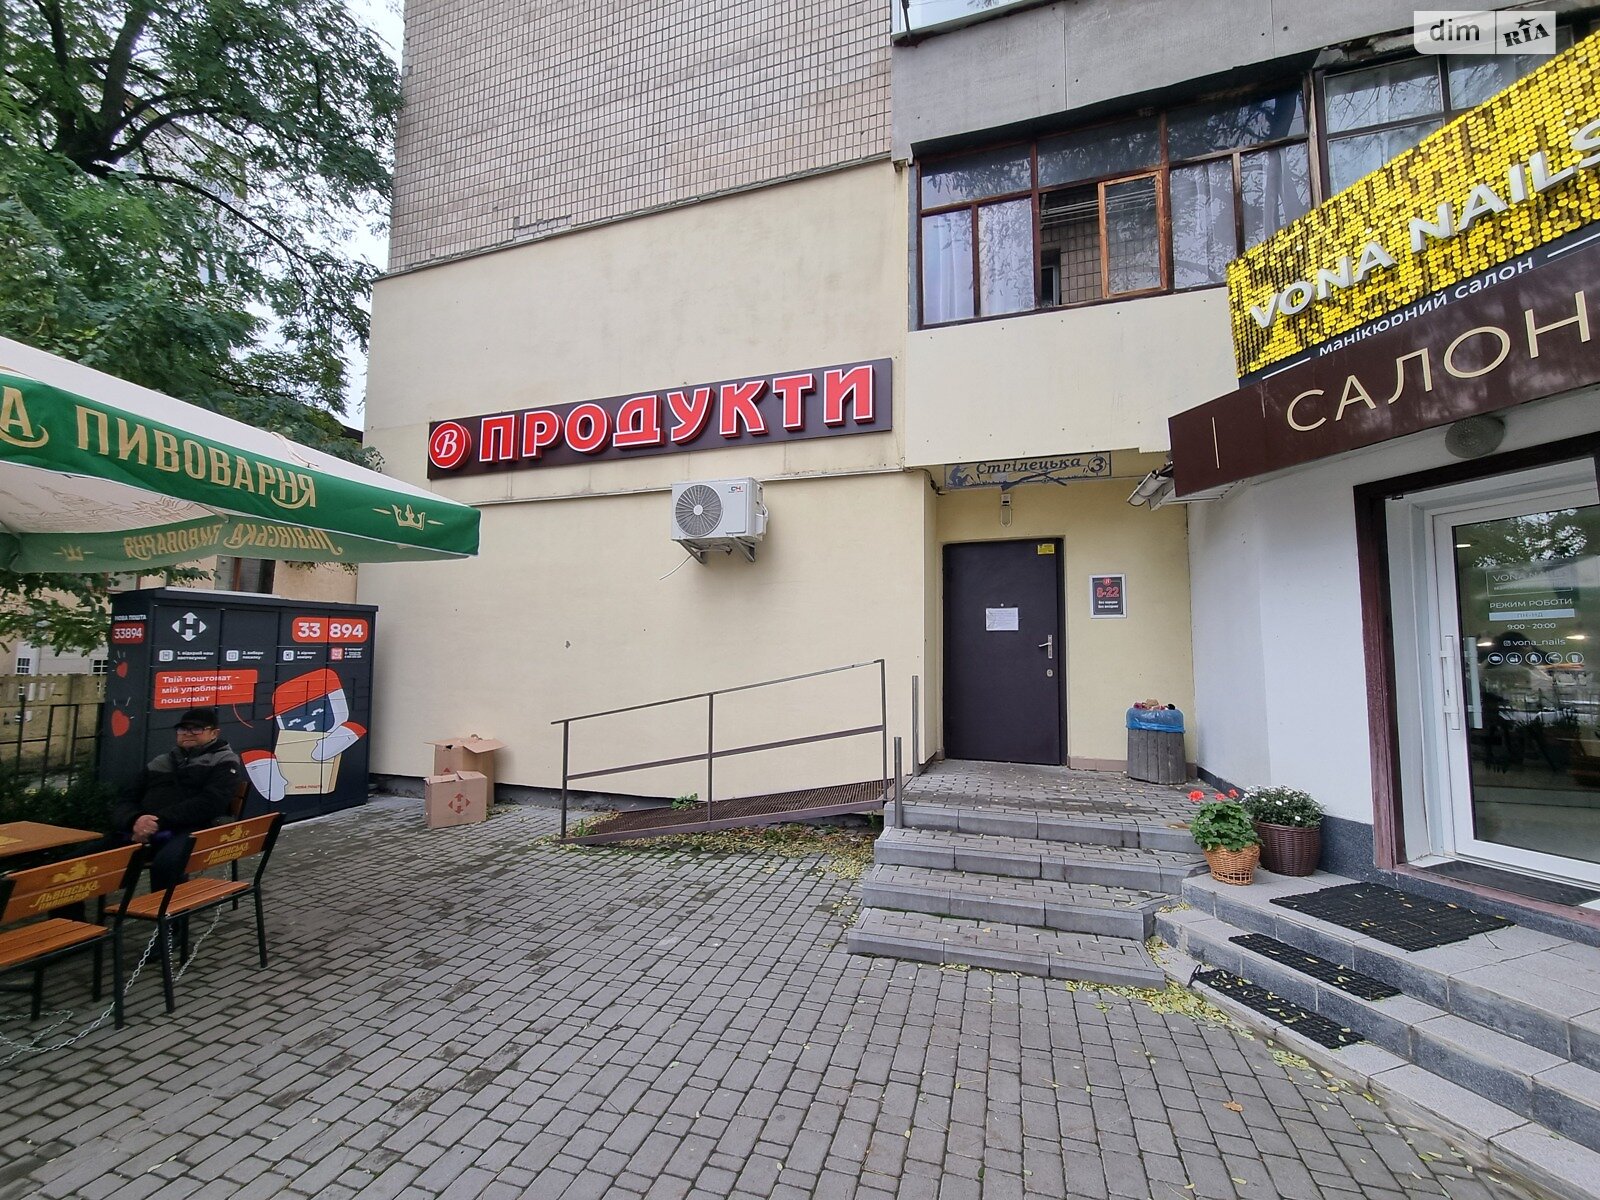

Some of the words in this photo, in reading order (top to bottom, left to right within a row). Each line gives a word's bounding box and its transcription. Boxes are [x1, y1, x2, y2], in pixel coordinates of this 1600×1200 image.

[1249, 241, 1398, 329] VONA
[1319, 293, 1447, 357] манікюрний
[1454, 257, 1534, 299] салон
[1286, 290, 1591, 432] САЛОН
[479, 365, 875, 463] ПРОДУКТИ
[76, 405, 316, 509] ПИВОВАРНЯ
[976, 457, 1081, 474] Стрілецька
[1090, 457, 1104, 473] 3
[1529, 598, 1573, 607] РОБОТИ
[114, 627, 142, 639] 33894
[297, 622, 321, 638] 33
[329, 623, 364, 638] 894
[1513, 638, 1566, 646] vona_nails
[162, 675, 183, 683] Твій
[185, 675, 232, 683] поштомат
[161, 686, 179, 694] мій
[180, 684, 233, 694] улюблений
[161, 696, 210, 704] поштомат
